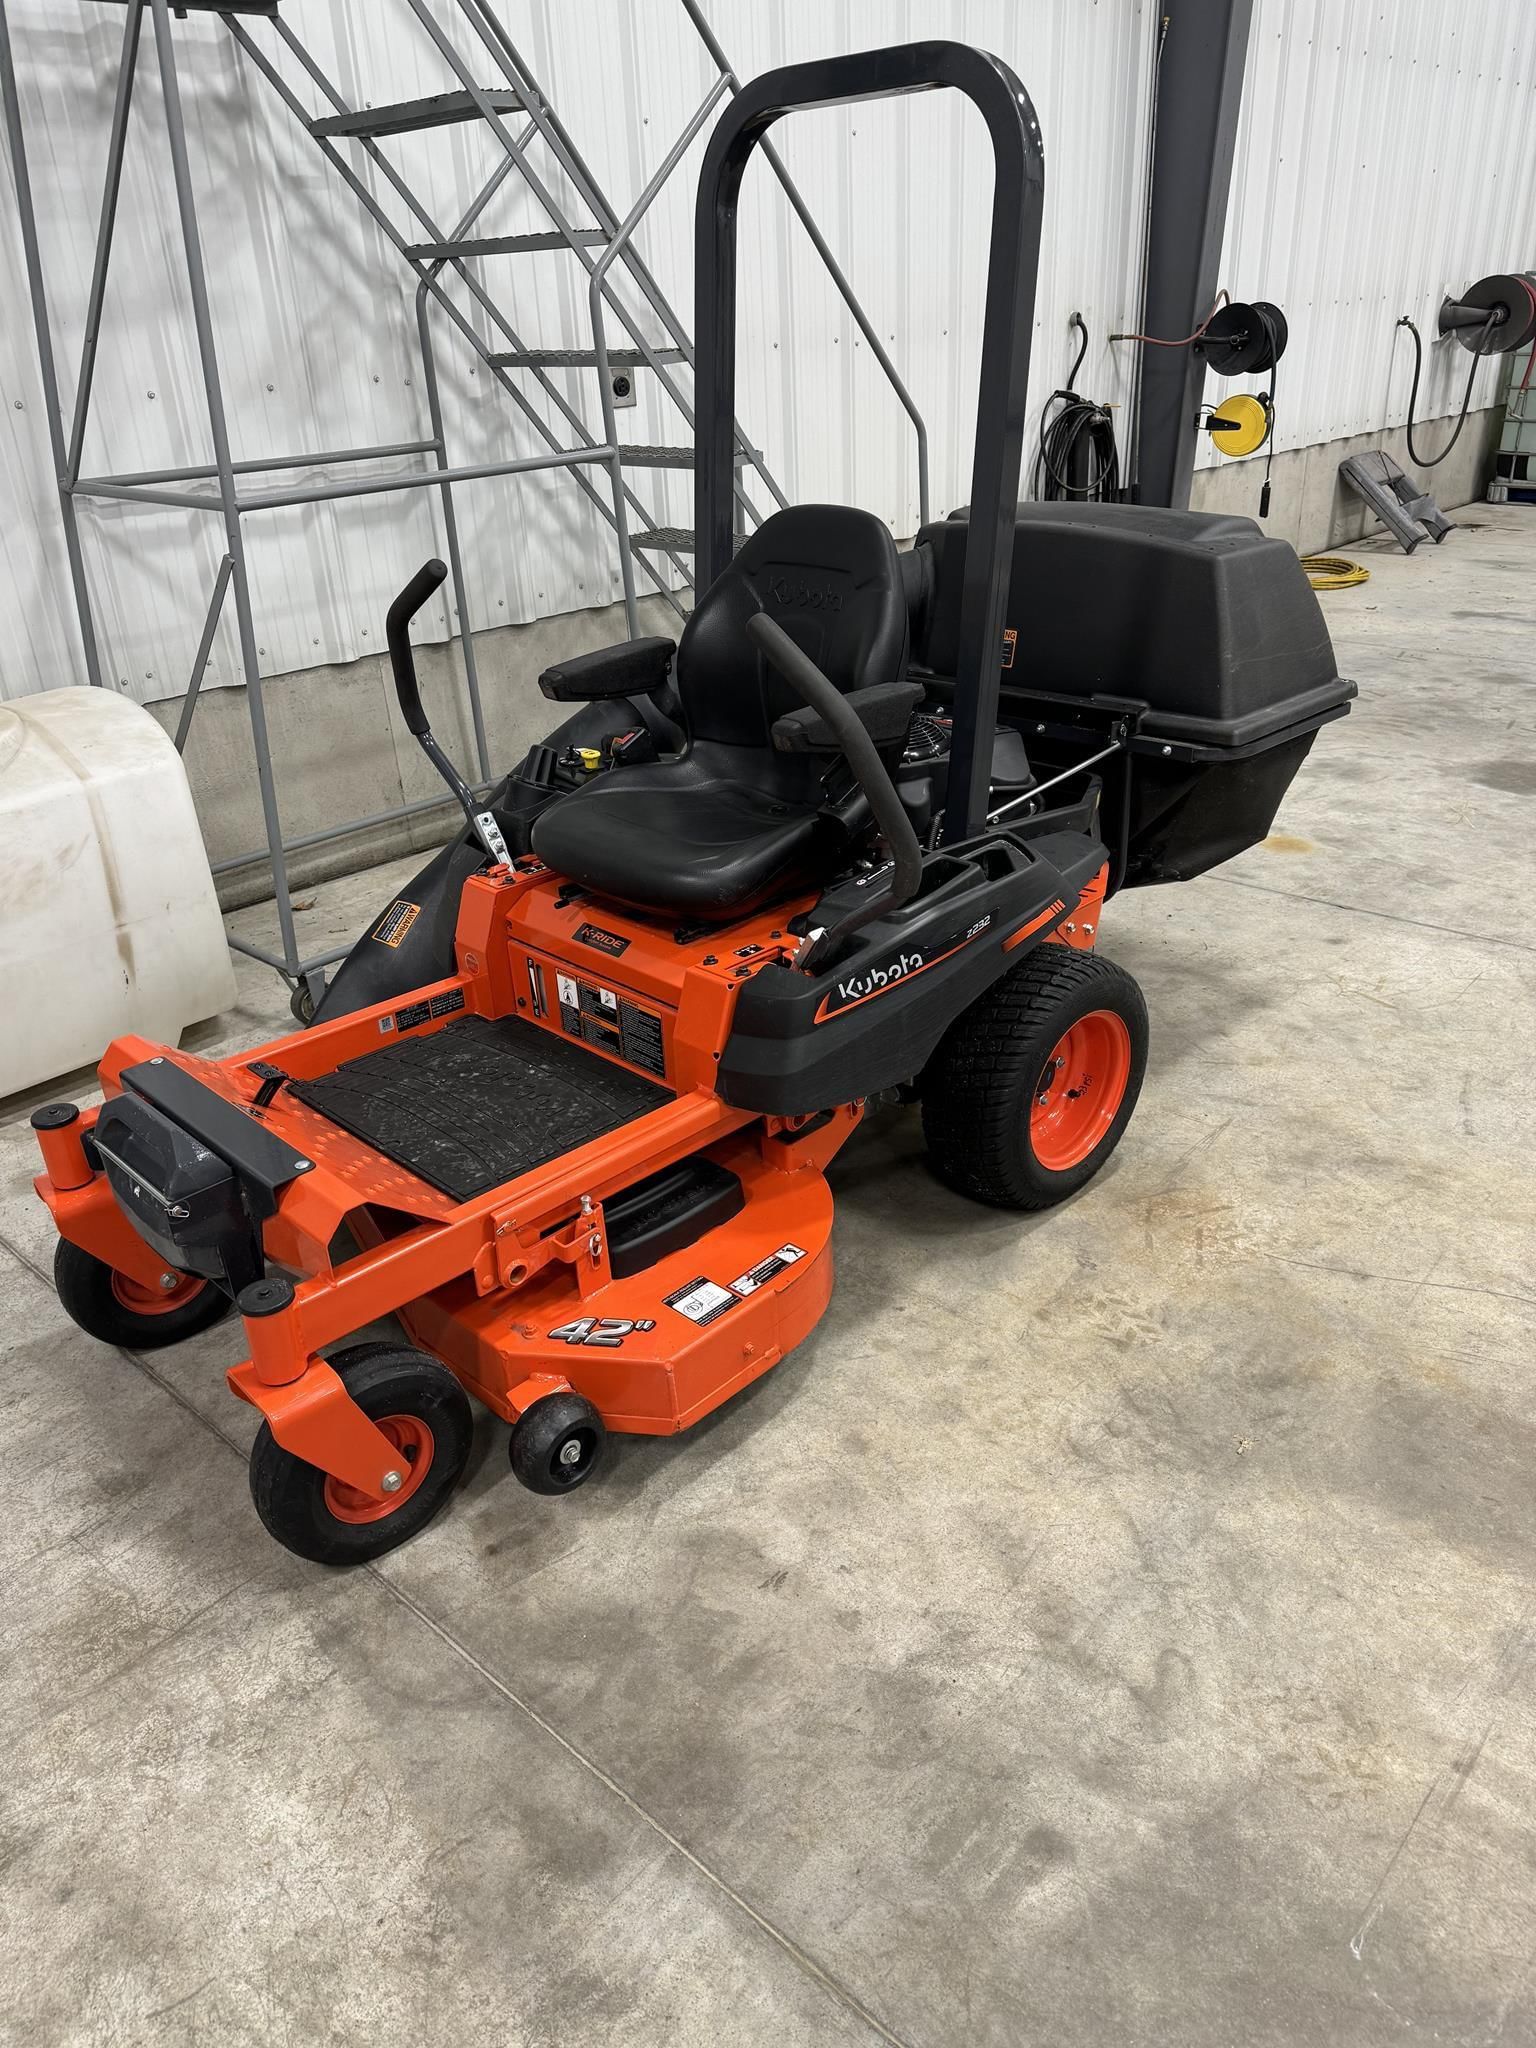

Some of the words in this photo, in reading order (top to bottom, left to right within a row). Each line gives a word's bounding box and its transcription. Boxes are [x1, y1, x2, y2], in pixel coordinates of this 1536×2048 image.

[765, 576, 843, 612] Kubota
[391, 914, 416, 945] WARNING
[581, 927, 625, 949] K-RIDE
[838, 951, 924, 999] Kubota
[548, 1317, 656, 1347] 42"
